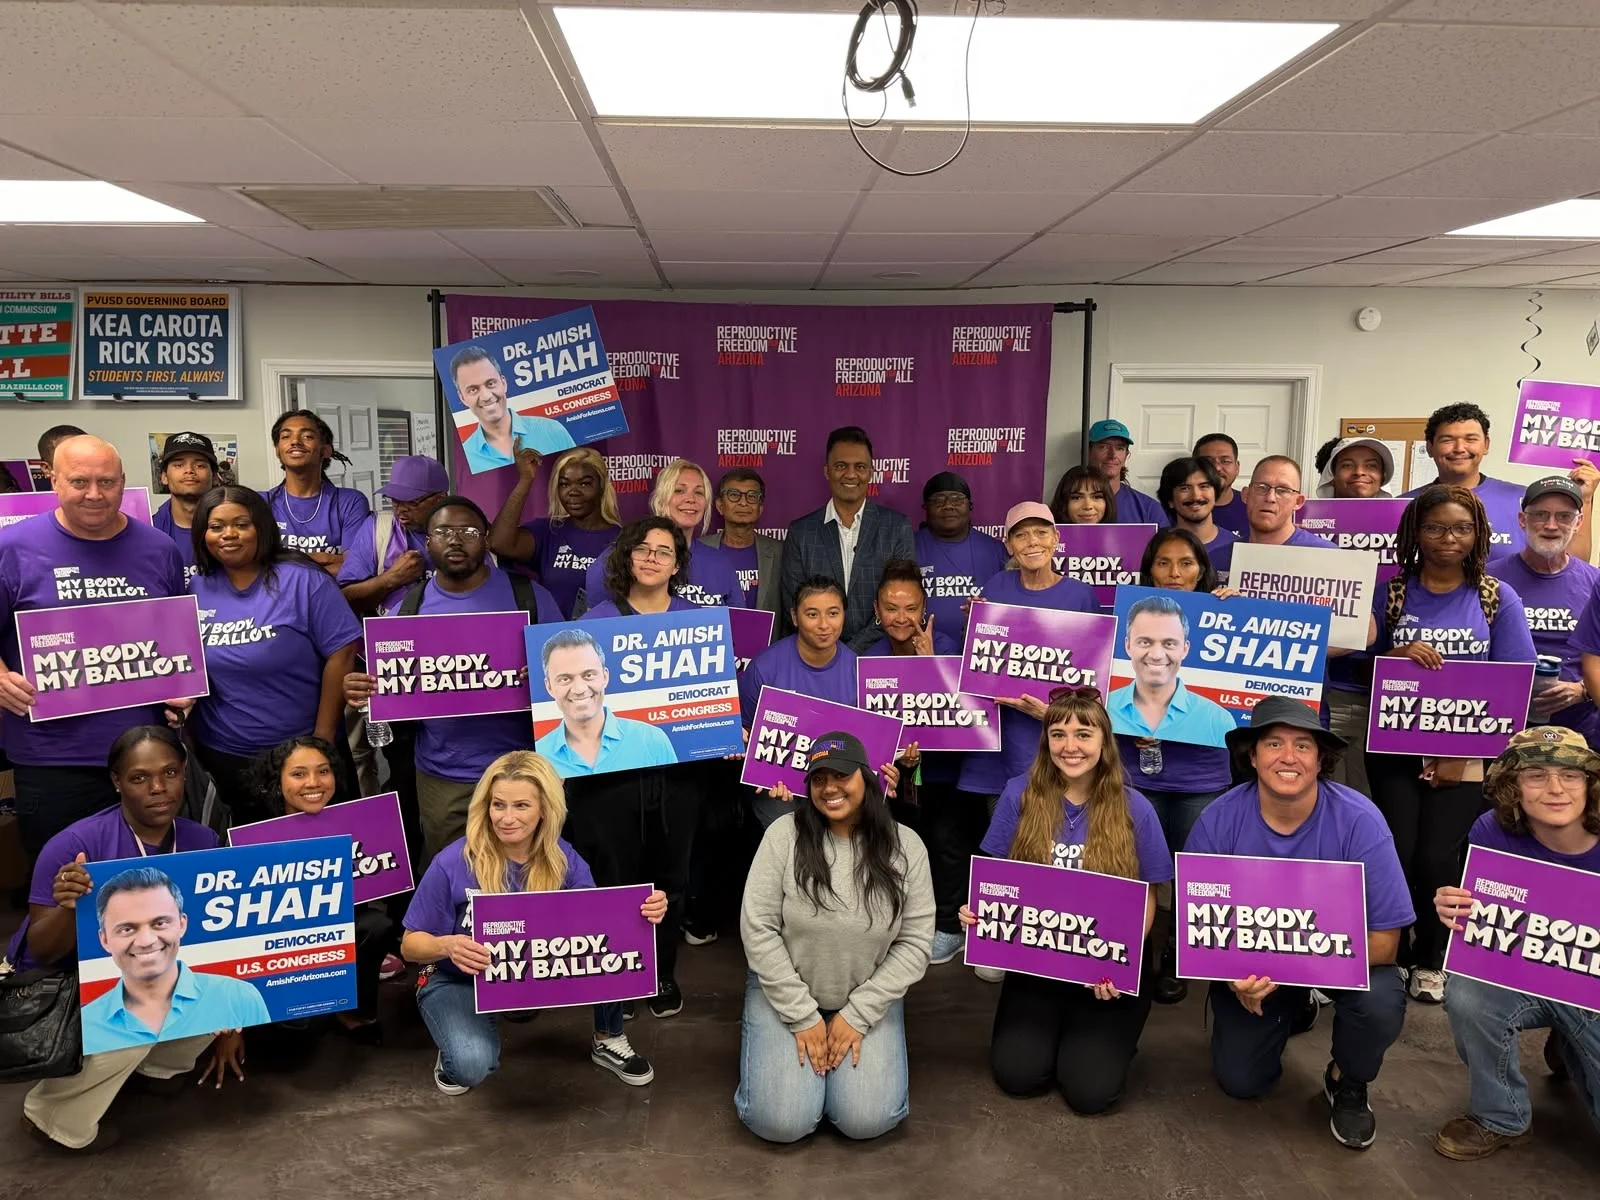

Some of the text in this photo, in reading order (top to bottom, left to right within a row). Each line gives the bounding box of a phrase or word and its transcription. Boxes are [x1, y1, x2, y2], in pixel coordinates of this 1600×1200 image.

[5, 305, 57, 314] COMMISSION
[87, 296, 226, 306] PVUSD GOVERNING BOARD
[90, 314, 223, 337] KEA CAROTA
[717, 326, 797, 340] REPRODUCTIVE
[952, 326, 1031, 340] REPRODUCTIVE
[503, 323, 591, 361] DR. AMISH
[717, 339, 797, 353] FREEDOM ALL
[952, 339, 1031, 353] FREEDOM ALL
[99, 341, 215, 365] RICK ROSS
[607, 351, 680, 366] EPRODUCTIVE
[718, 352, 764, 365] ARIZONA
[952, 352, 997, 366] ARIZONA
[514, 341, 598, 387] SHAH
[835, 357, 914, 370] REPRODUCTIVE
[88, 370, 225, 383] STUDENTS FIRST, ALWAYS!
[659, 367, 680, 379] ALL
[835, 370, 914, 384] FREEDOM ALL
[557, 376, 607, 397] DEMOCRAT
[835, 384, 881, 397] ARIZONA
[544, 391, 611, 416] U.S. CONGRESS
[1522, 413, 1600, 435] MY BOD
[718, 429, 796, 442] REPRODUCTIVE
[948, 427, 1026, 441] REPRODUCTIVE
[1520, 428, 1556, 446] MY
[718, 442, 796, 455] FREEDOM ALL
[947, 440, 1025, 453] FREEDOM ALL
[719, 454, 763, 467] ARIZONA
[947, 453, 992, 466] ARIZONA
[607, 467, 652, 481] REEDOM
[891, 471, 909, 483] ALL
[288, 534, 328, 548] BODY.
[1339, 533, 1398, 548] BODY.
[556, 554, 572, 562] MY
[1052, 557, 1122, 571] Y BODY.
[56, 577, 128, 590] MY BODY.
[922, 576, 974, 587] Y BODY.
[1069, 571, 1141, 586] BALLOT
[1239, 571, 1363, 600] REPRODUCTIVE
[58, 586, 148, 600] MY BALLOT.
[936, 586, 984, 597] BALLO
[1314, 596, 1358, 618] FOR ALL
[1523, 607, 1572, 619] BODY.
[211, 617, 255, 634] BODY.
[1199, 611, 1321, 641] DR. AMISH
[207, 624, 277, 646] BALLOT.
[612, 625, 723, 652] DR. AMISH
[1393, 628, 1474, 641] MY BODY.
[33, 640, 157, 672] MY BODY.
[972, 639, 1070, 665] MY BODY.
[1200, 634, 1318, 673] SHAH
[36, 655, 192, 691] MY BALLOT.
[376, 653, 489, 676] MY BODY.
[619, 645, 725, 684] SHAH
[970, 655, 1096, 686] MY BALLOT.
[378, 669, 520, 694] MY BALLOT.
[1245, 680, 1313, 697] DEMOCRAT
[668, 686, 730, 701] DEMOCRAT
[866, 693, 960, 709] MY BODY.
[1219, 694, 1242, 706] U.S.
[648, 702, 733, 722] U.S. CONGRESS
[1380, 696, 1487, 716] MY BODY.
[671, 719, 734, 733] AmishForArizona.com
[903, 710, 988, 725] BALLOT.
[1378, 712, 1513, 734] MY BALLOT.
[758, 726, 795, 748] MY
[755, 743, 790, 765] MY
[194, 869, 242, 894] DR.
[250, 857, 343, 887] AMISH
[1187, 882, 1231, 891] REPRODUCTIVE
[1187, 889, 1215, 897] FREEDOM
[1475, 885, 1527, 904] FREEDOM ALL
[1476, 878, 1528, 897] REPRODUCTIVE
[201, 881, 344, 932] SHAH
[483, 920, 525, 930] REPRODUCTIVE
[978, 900, 1095, 936] MY BODY.
[1187, 903, 1315, 930] MY BODY.
[1469, 899, 1600, 949] MY BOD
[264, 929, 346, 951] DEMOCRAT
[483, 934, 608, 960] MY BODY.
[977, 919, 1128, 963] MY BALLOT.
[1187, 925, 1352, 955] MY BALLOT.
[1464, 921, 1600, 977] MY BALL
[236, 949, 346, 976] U.S. CONGRESS
[485, 951, 642, 982] MY BALLOT.
[266, 967, 347, 988] AmishForArizona.com
